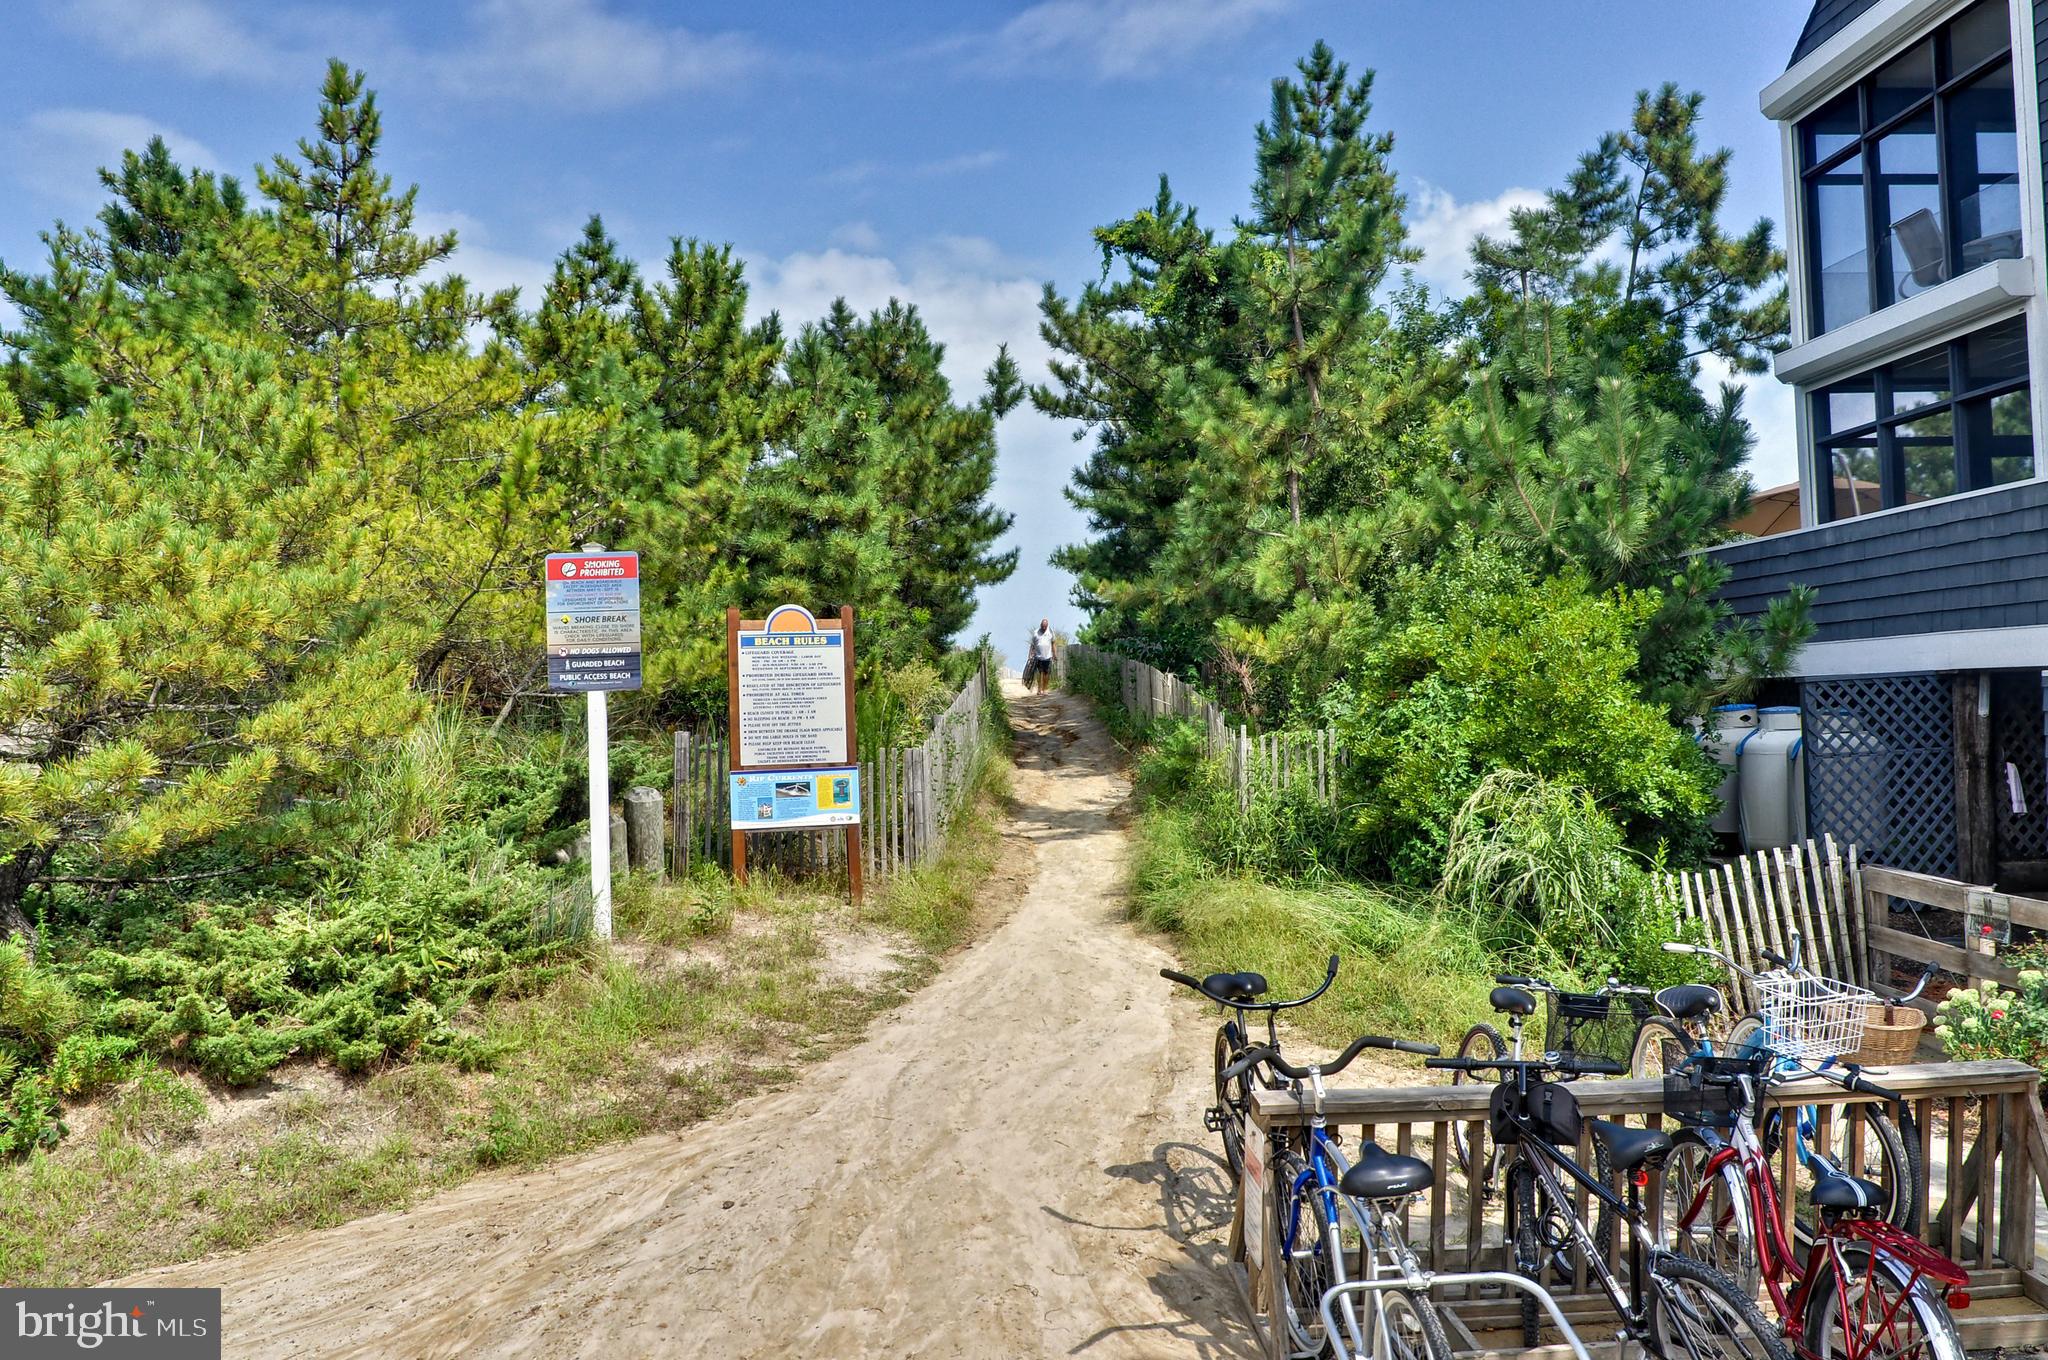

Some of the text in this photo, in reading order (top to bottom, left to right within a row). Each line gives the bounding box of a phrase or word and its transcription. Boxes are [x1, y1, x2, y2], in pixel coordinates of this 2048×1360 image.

[584, 560, 620, 569] SMOKING
[580, 567, 624, 577] PROHIBITED
[574, 615, 600, 623] SHORE
[754, 636, 827, 646] BEACH RULES
